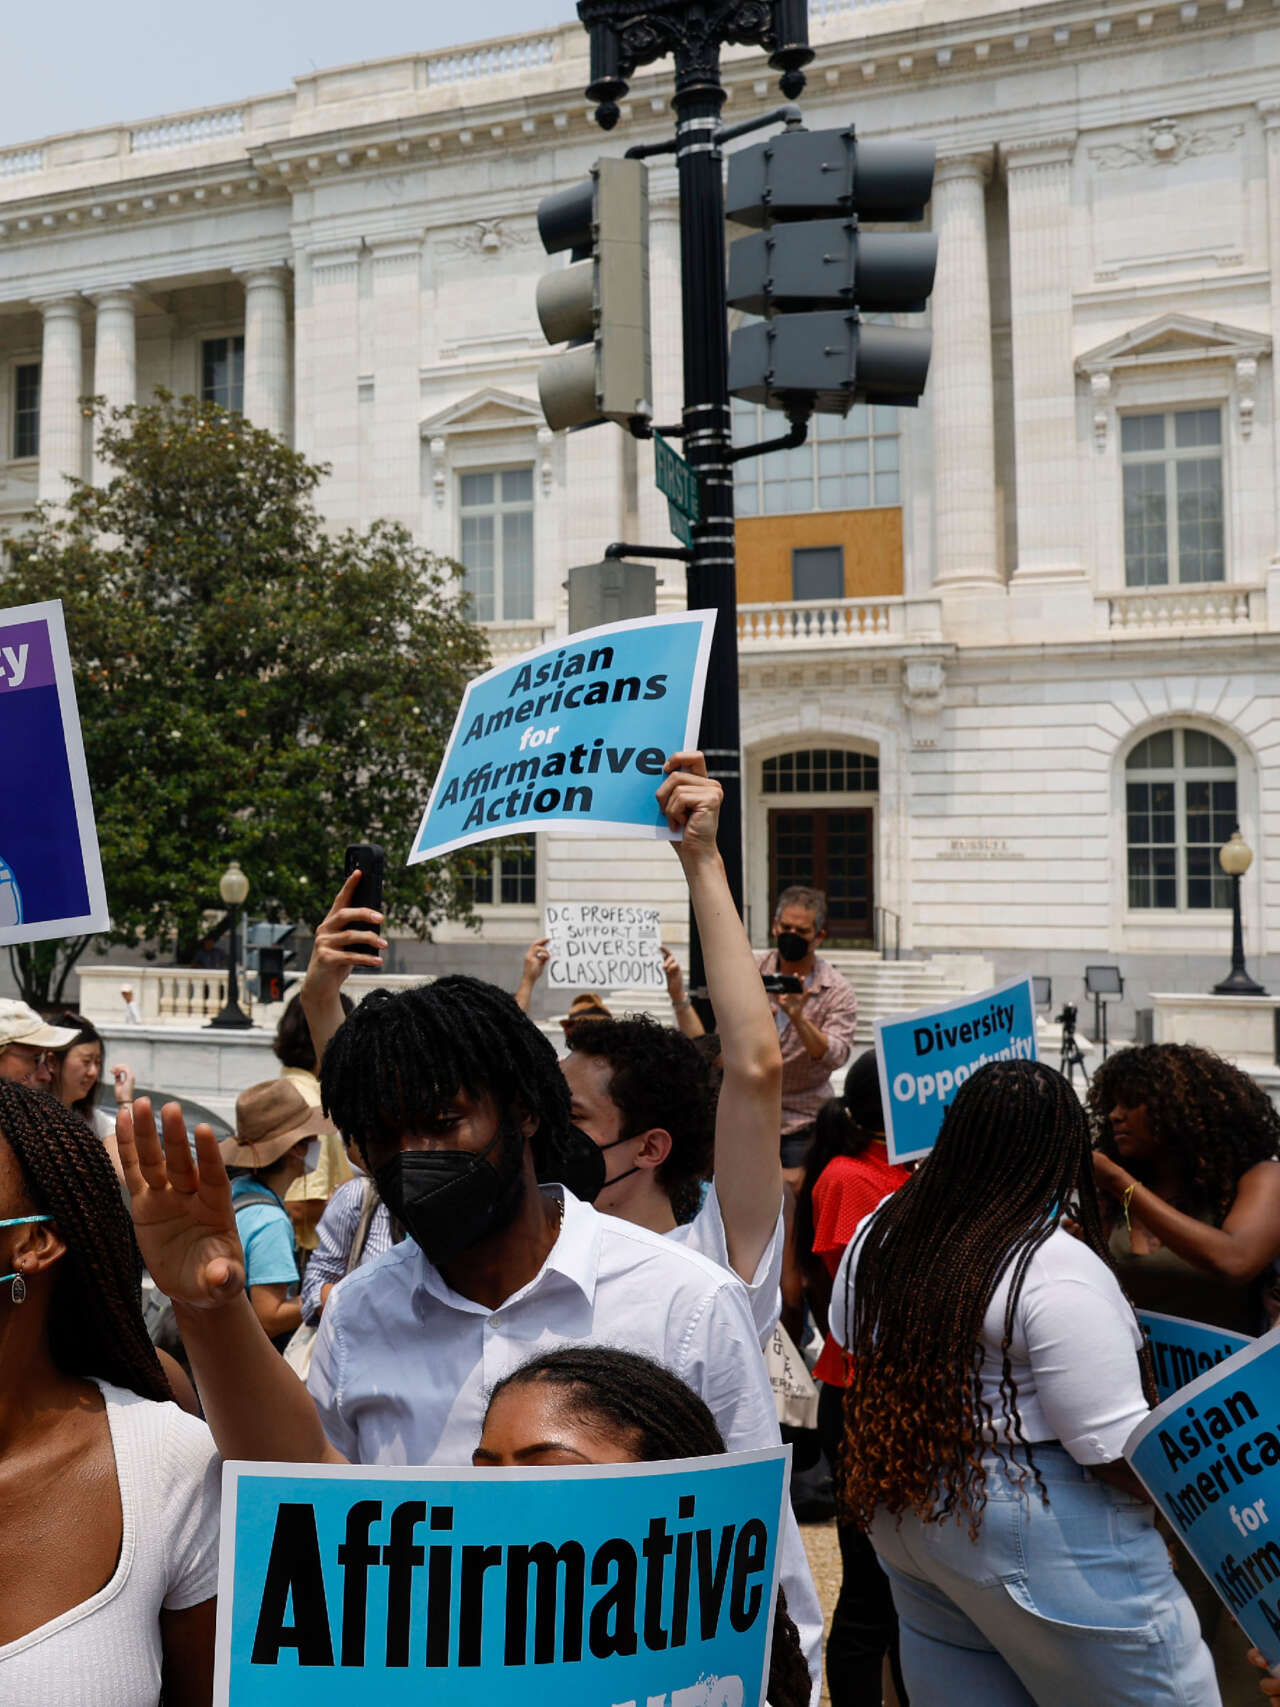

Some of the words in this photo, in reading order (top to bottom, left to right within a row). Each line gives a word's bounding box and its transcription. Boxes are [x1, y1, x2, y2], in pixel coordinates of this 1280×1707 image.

[656, 442, 689, 511] FIRST
[508, 646, 614, 698] Asian
[461, 673, 668, 746] Americans
[519, 725, 560, 751] for
[437, 738, 666, 810] Affirmative
[462, 782, 593, 831] Action
[567, 925, 631, 939] SUPPORT
[581, 905, 661, 925] PROFESSOR
[550, 960, 664, 985] CLASSROOMS
[566, 940, 650, 957] DIVERSE
[914, 1003, 1015, 1056] Diversity
[1158, 1390, 1259, 1473] Asian
[1164, 1423, 1280, 1533] America
[1229, 1498, 1269, 1537] for
[250, 1495, 768, 1667] Affirmative
